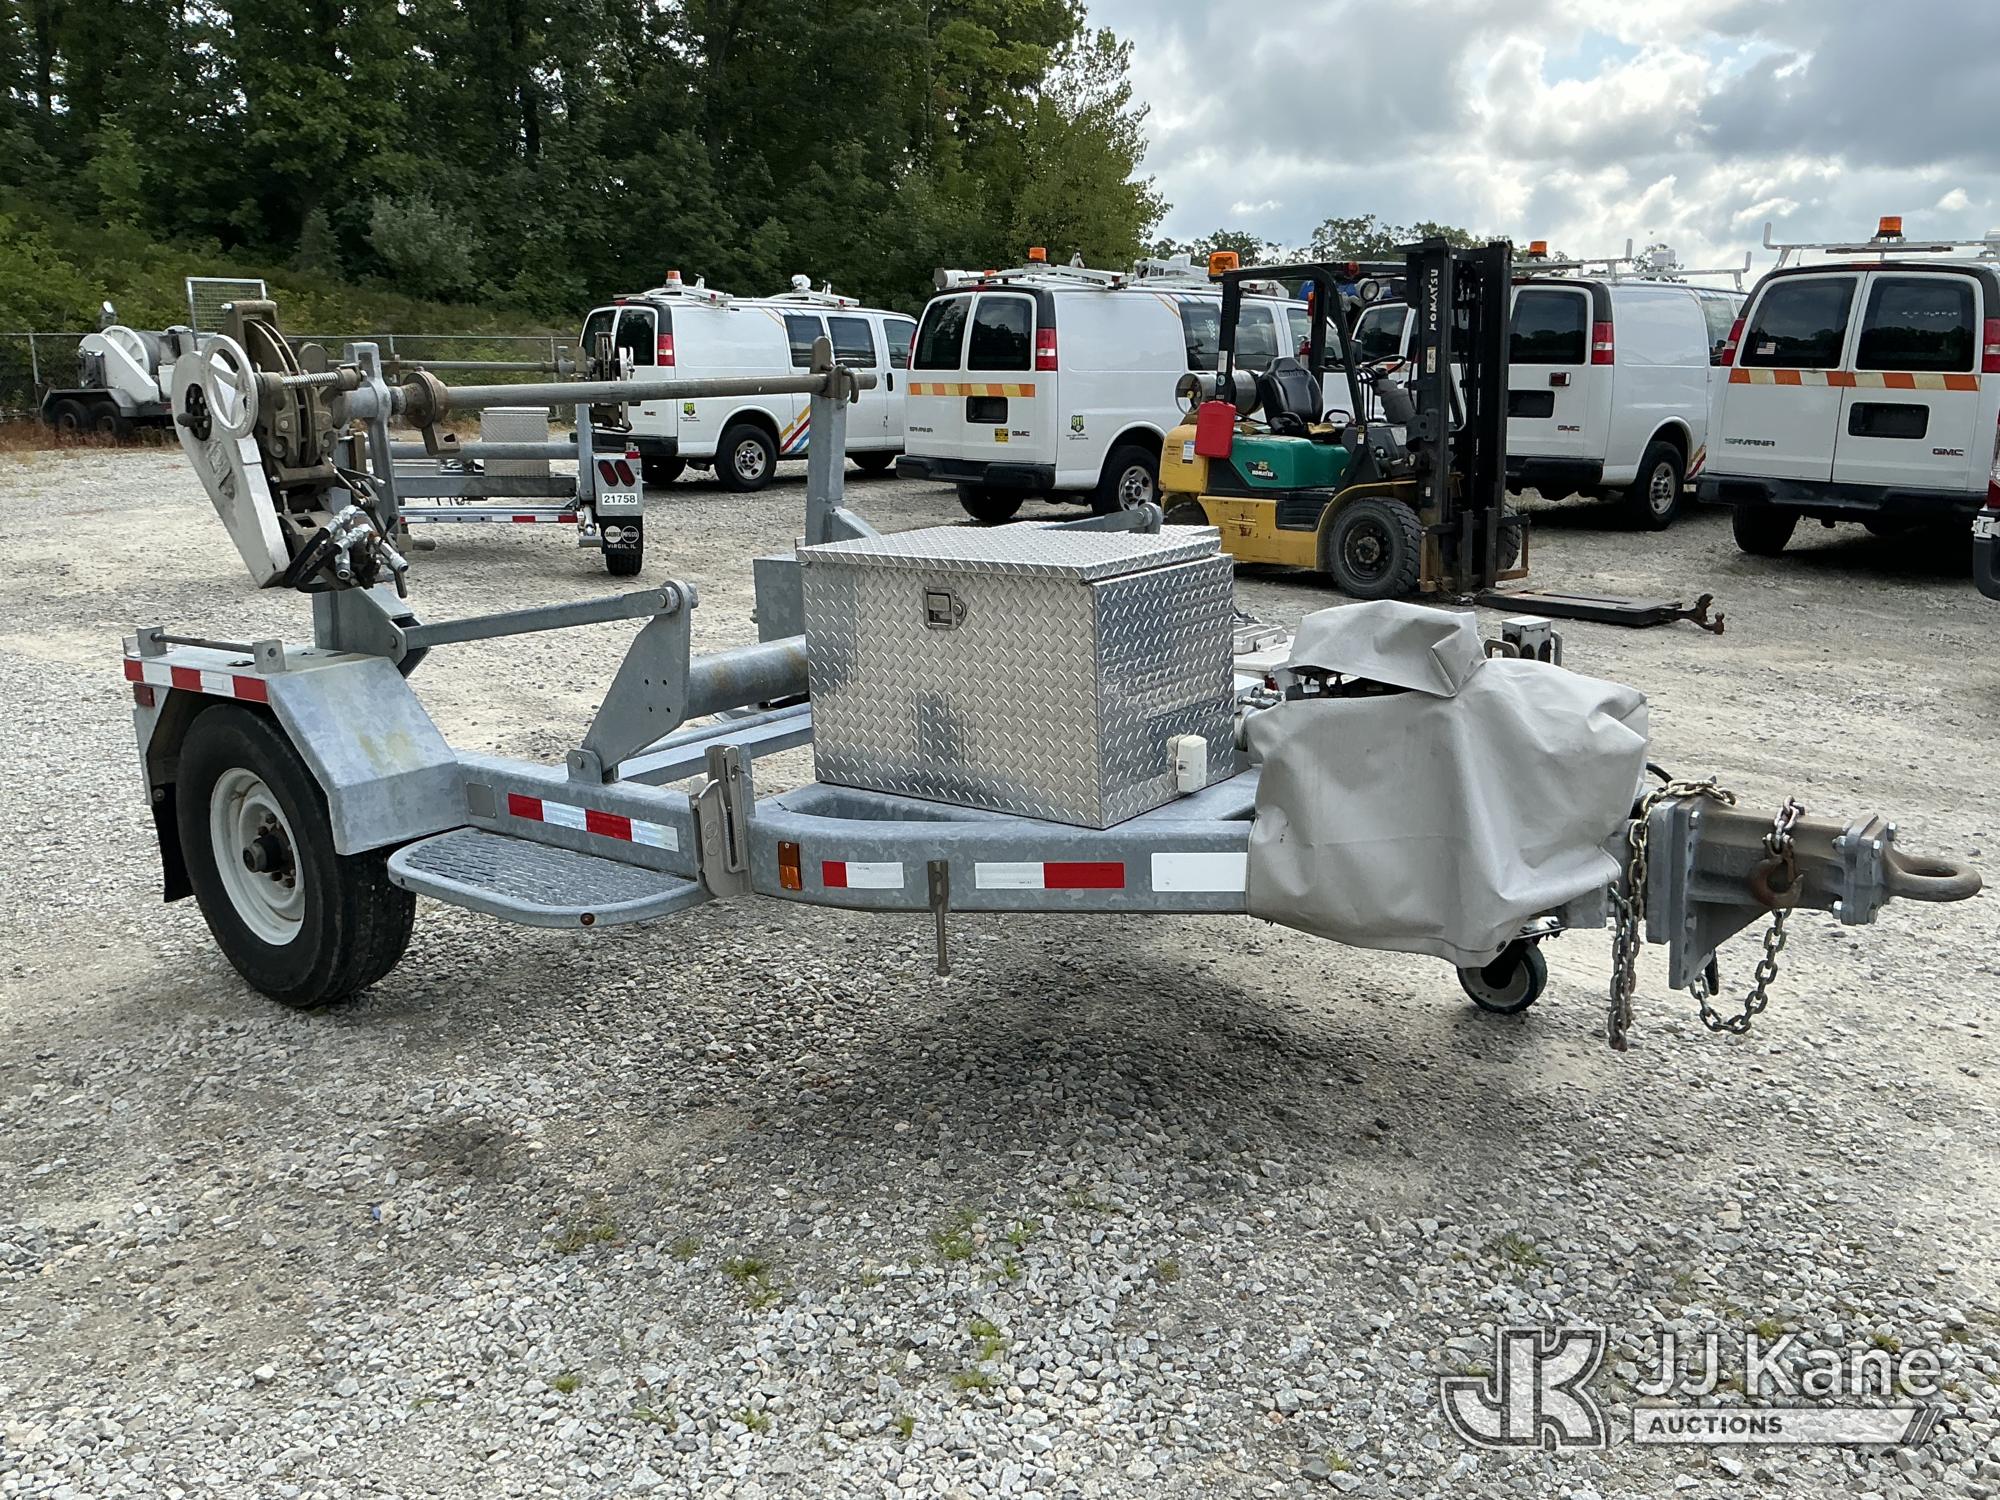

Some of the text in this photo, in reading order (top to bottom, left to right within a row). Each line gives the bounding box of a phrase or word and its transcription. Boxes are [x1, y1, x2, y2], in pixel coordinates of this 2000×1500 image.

[1428, 268, 1439, 331] KOMATSU
[1557, 424, 1580, 432] GMC
[1932, 447, 1965, 457] GMC
[604, 495, 636, 504] 21758
